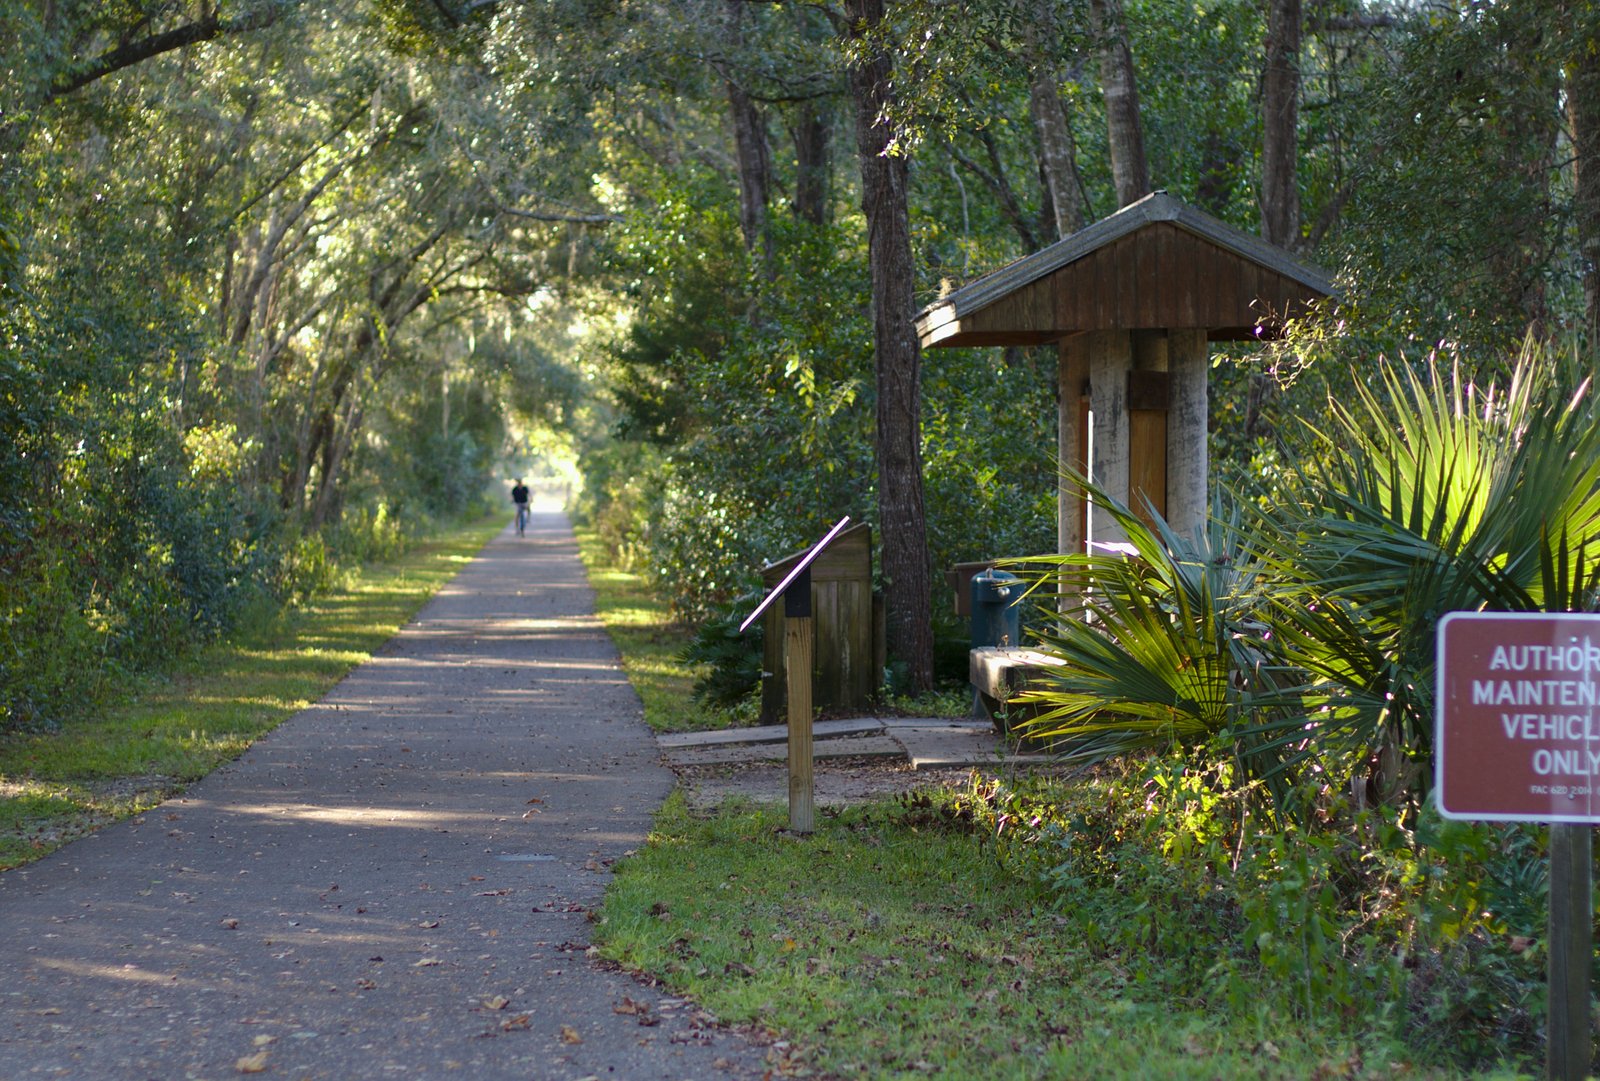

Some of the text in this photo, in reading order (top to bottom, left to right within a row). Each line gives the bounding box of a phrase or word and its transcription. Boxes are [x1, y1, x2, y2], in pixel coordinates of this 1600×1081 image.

[1489, 646, 1600, 671] AUTHOR
[1472, 680, 1600, 706] MAINTEN
[1502, 714, 1600, 740] VEHICL
[1533, 749, 1600, 775] ONLY
